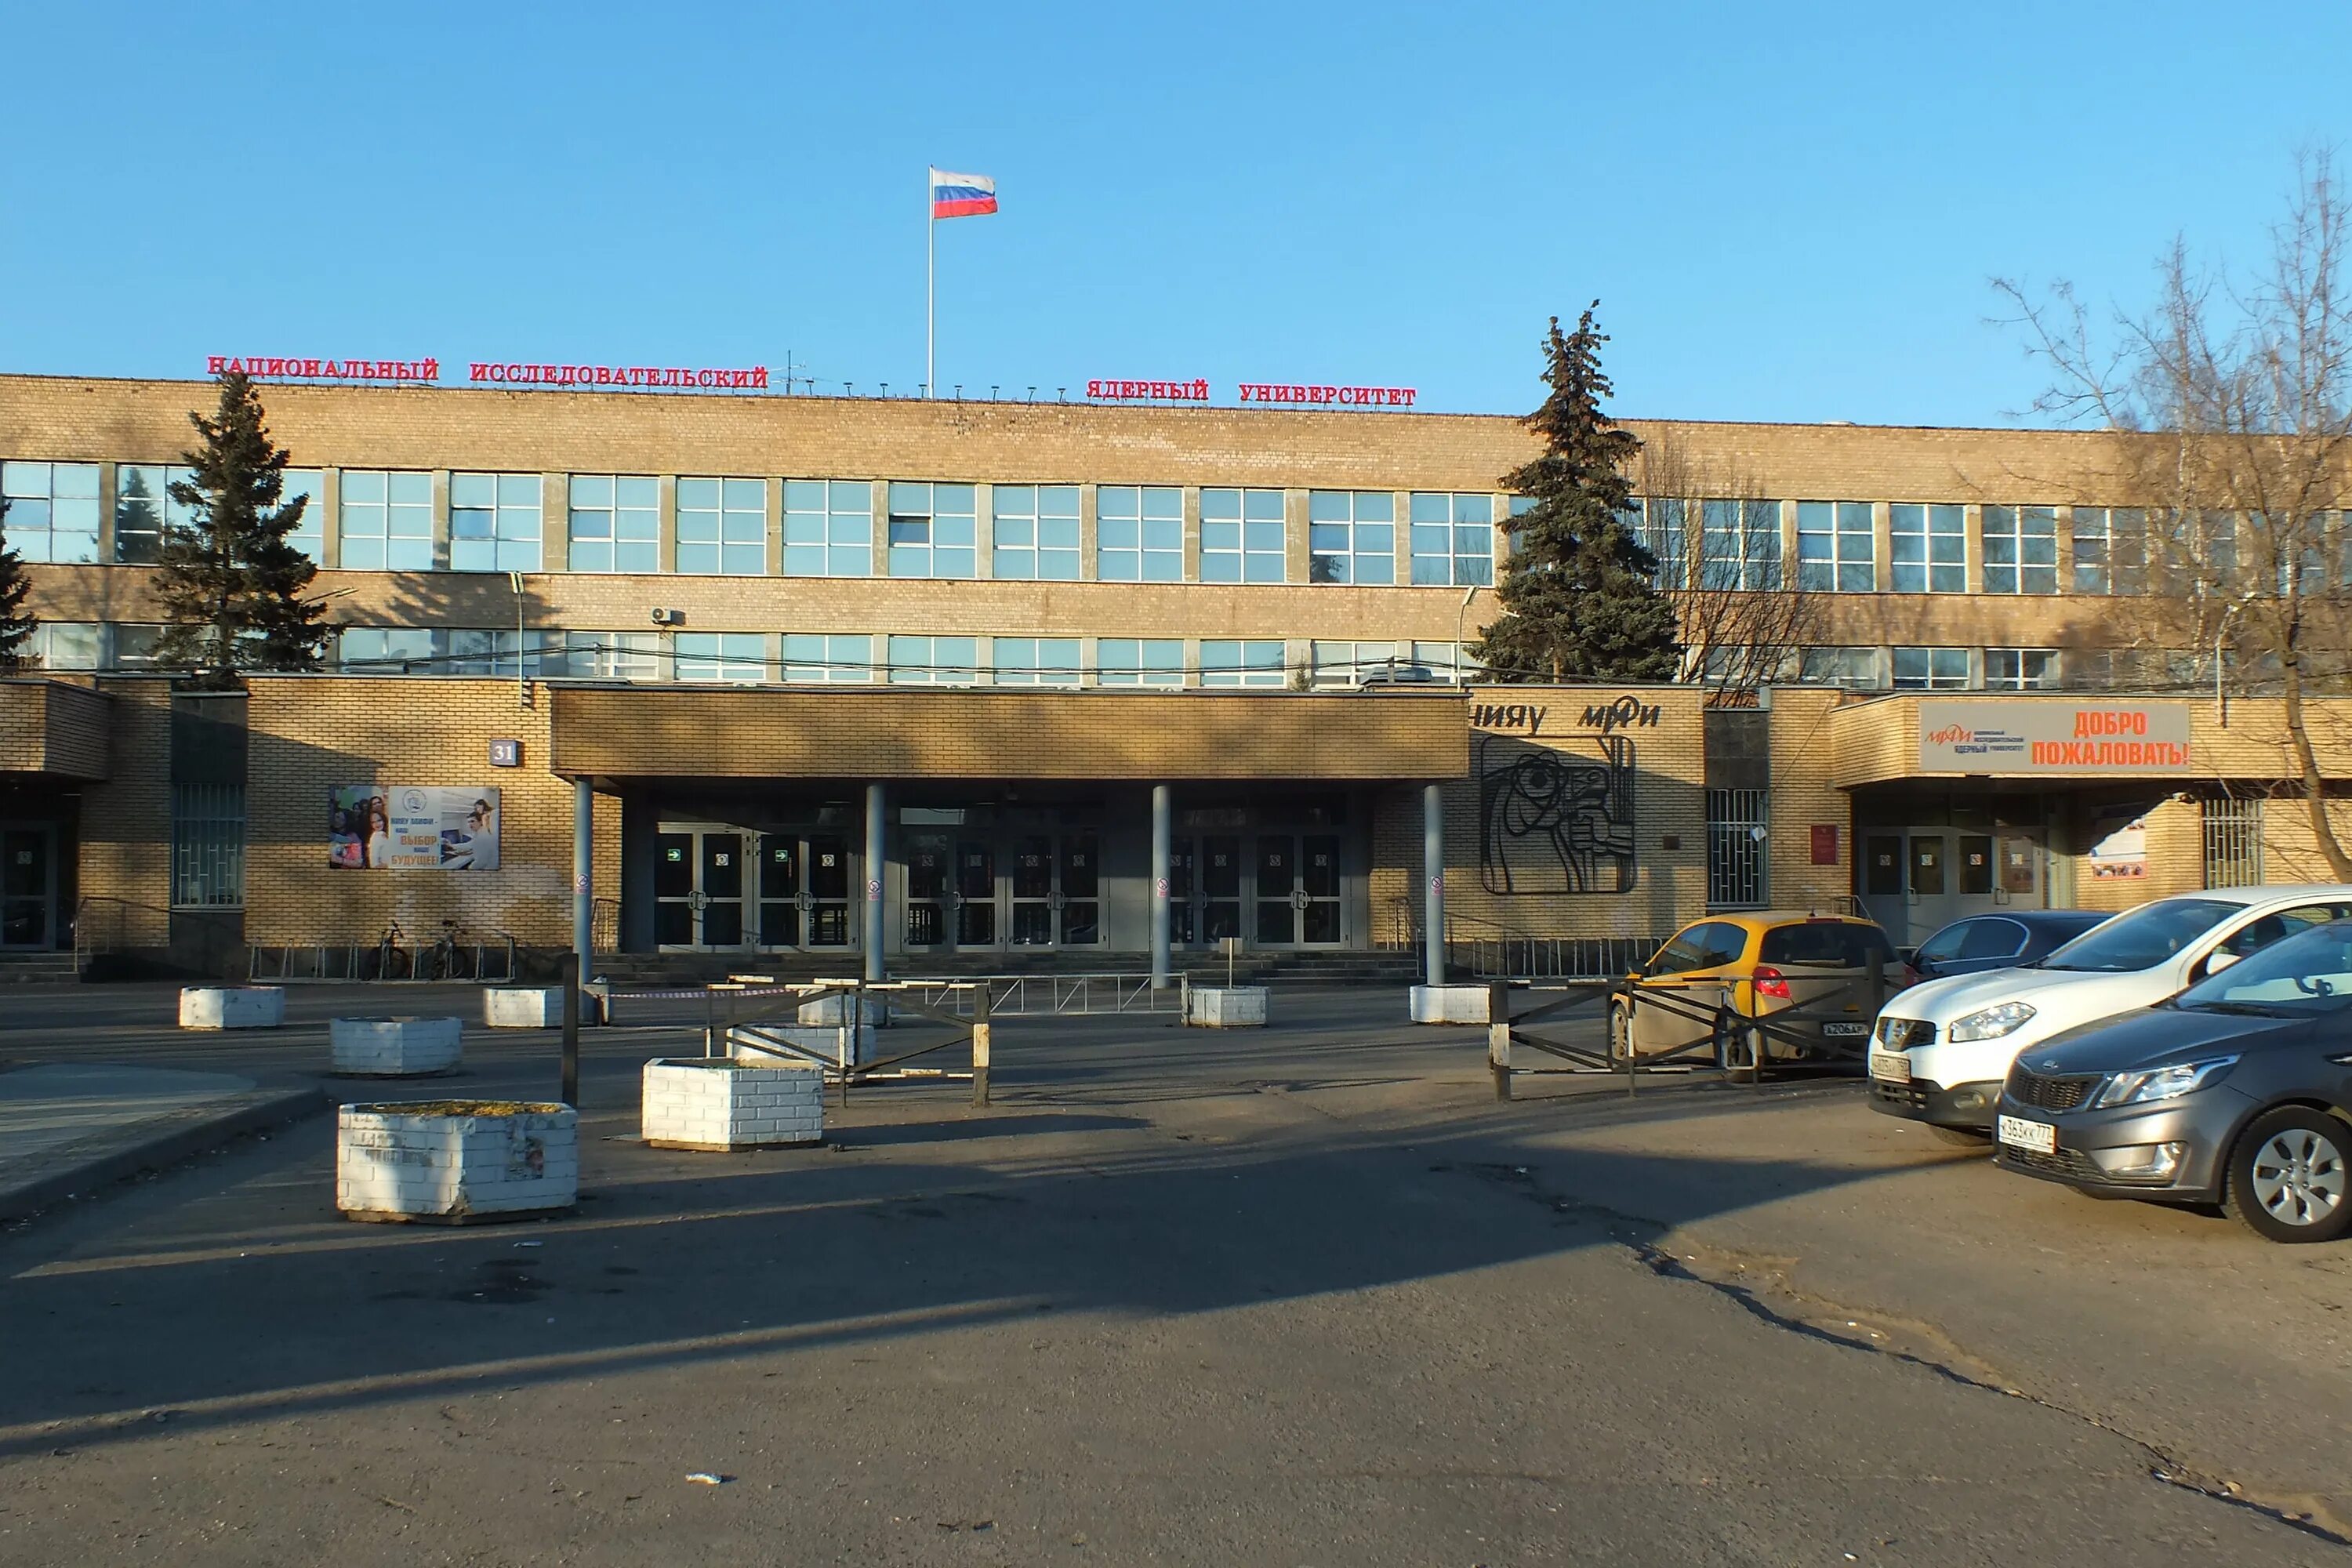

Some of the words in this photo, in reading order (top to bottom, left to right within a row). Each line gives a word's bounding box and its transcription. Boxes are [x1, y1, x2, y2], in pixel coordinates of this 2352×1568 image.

[208, 356, 439, 380] НАЦИОНАЛЬНЫЙ
[470, 363, 769, 388] ИССЛЕДОВАТЕЛЬСКИЙ
[1087, 379, 1209, 401] ЯДЕРНЫЙ
[1239, 383, 1417, 406] УНИВЕРСИТЕТ
[2074, 712, 2147, 739] ДОБРО
[494, 745, 513, 760] 31
[2031, 741, 2190, 765] ПОЖАЛОВАТЬ!
